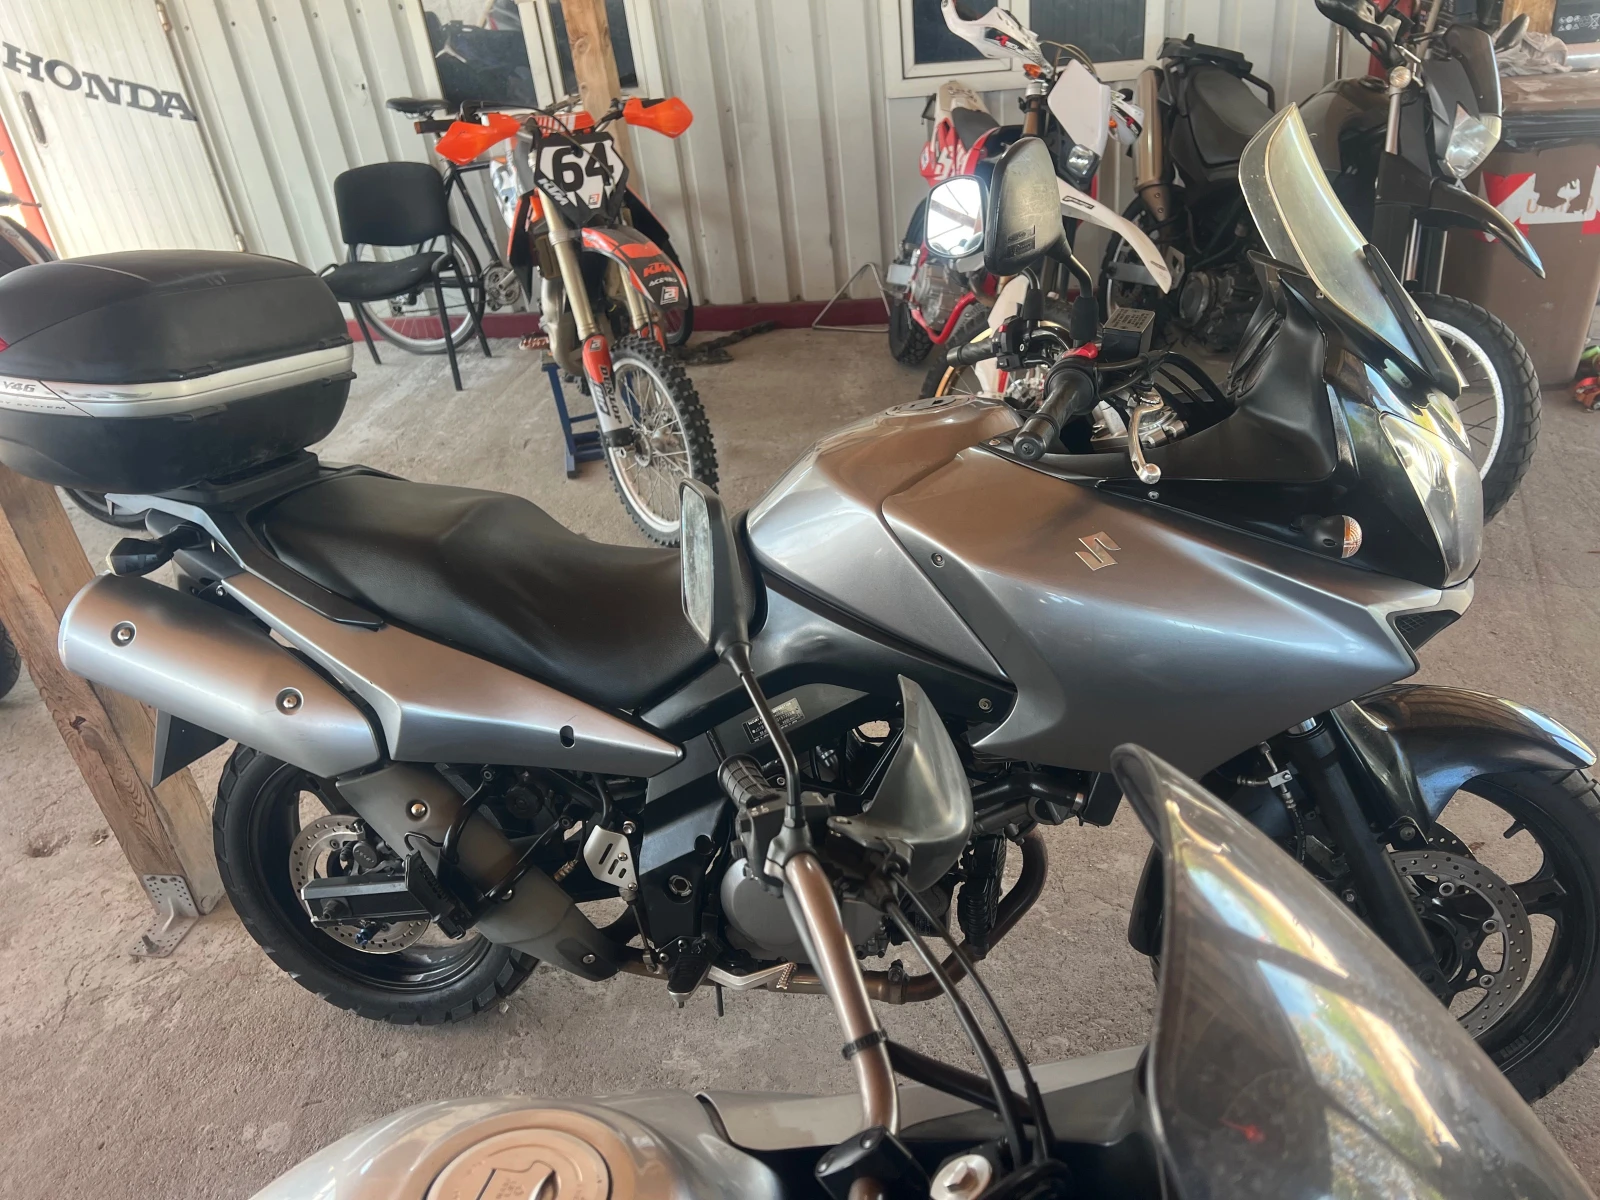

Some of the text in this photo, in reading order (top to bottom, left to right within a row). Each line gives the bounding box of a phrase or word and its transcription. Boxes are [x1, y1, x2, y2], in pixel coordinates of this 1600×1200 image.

[2, 41, 198, 122] HONDA
[552, 142, 614, 192] 64
[537, 178, 569, 206] KTM
[643, 261, 672, 278] KTM
[3, 381, 37, 393] V46
[600, 366, 623, 424] DUNLOP
